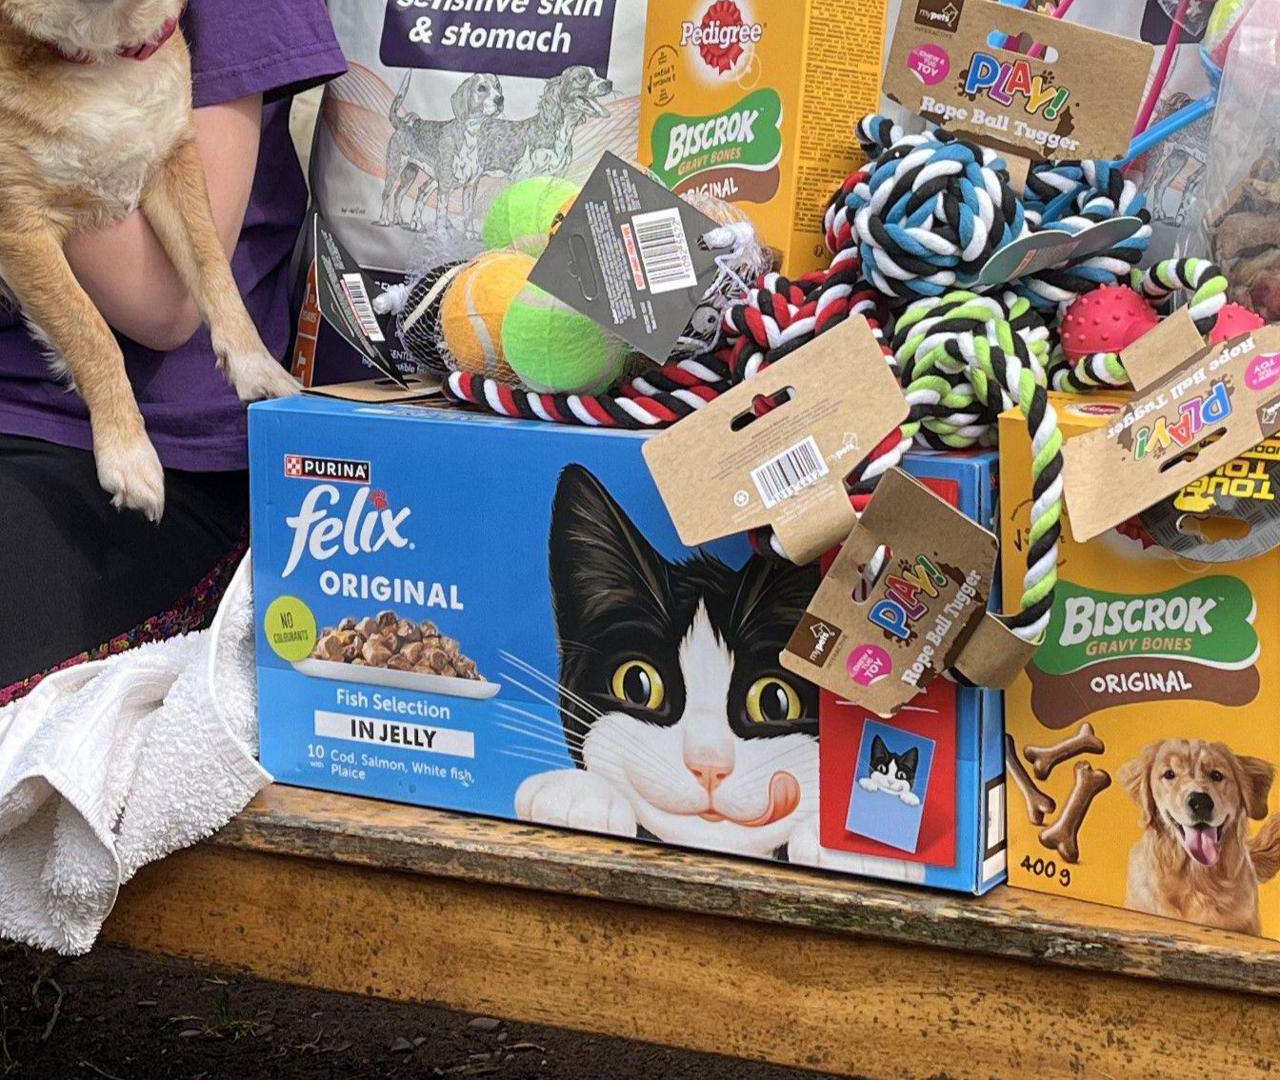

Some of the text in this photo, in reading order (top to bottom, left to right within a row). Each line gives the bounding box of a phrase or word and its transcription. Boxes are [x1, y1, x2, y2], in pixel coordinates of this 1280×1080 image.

[920, 8, 950, 23] mypets
[408, 16, 571, 54] & stomach
[680, 20, 763, 47] Pedigree
[917, 63, 939, 77] TOY
[964, 51, 1070, 121] PLAY!
[921, 96, 1080, 151] Rope Ball Tugger
[664, 110, 760, 172] BISCROK
[678, 147, 742, 175] GRAVY BONES
[1254, 359, 1275, 373] TOY
[1106, 337, 1256, 439] Rope Ball Tugger
[1134, 381, 1233, 461] PLAY!
[304, 460, 366, 478] PURINA
[281, 484, 411, 578] felix
[319, 570, 464, 610] ORIGINAL
[867, 554, 948, 639] PLAY!
[280, 612, 294, 629] NO
[901, 570, 981, 686] Rope Ball Tugger
[1058, 596, 1217, 647] BISCROK
[273, 630, 308, 644] COLOURANTS
[1085, 636, 1192, 656] GRAVY BONES
[864, 657, 883, 678] TOY
[1089, 668, 1192, 694] ORIGINAL
[336, 688, 450, 720] Fish Selection
[351, 719, 437, 748] IN JELLY
[308, 744, 324, 760] 10
[330, 749, 356, 765] Cod,
[361, 753, 408, 773] Salmon,
[412, 762, 447, 778] White
[331, 764, 366, 780] Plaice
